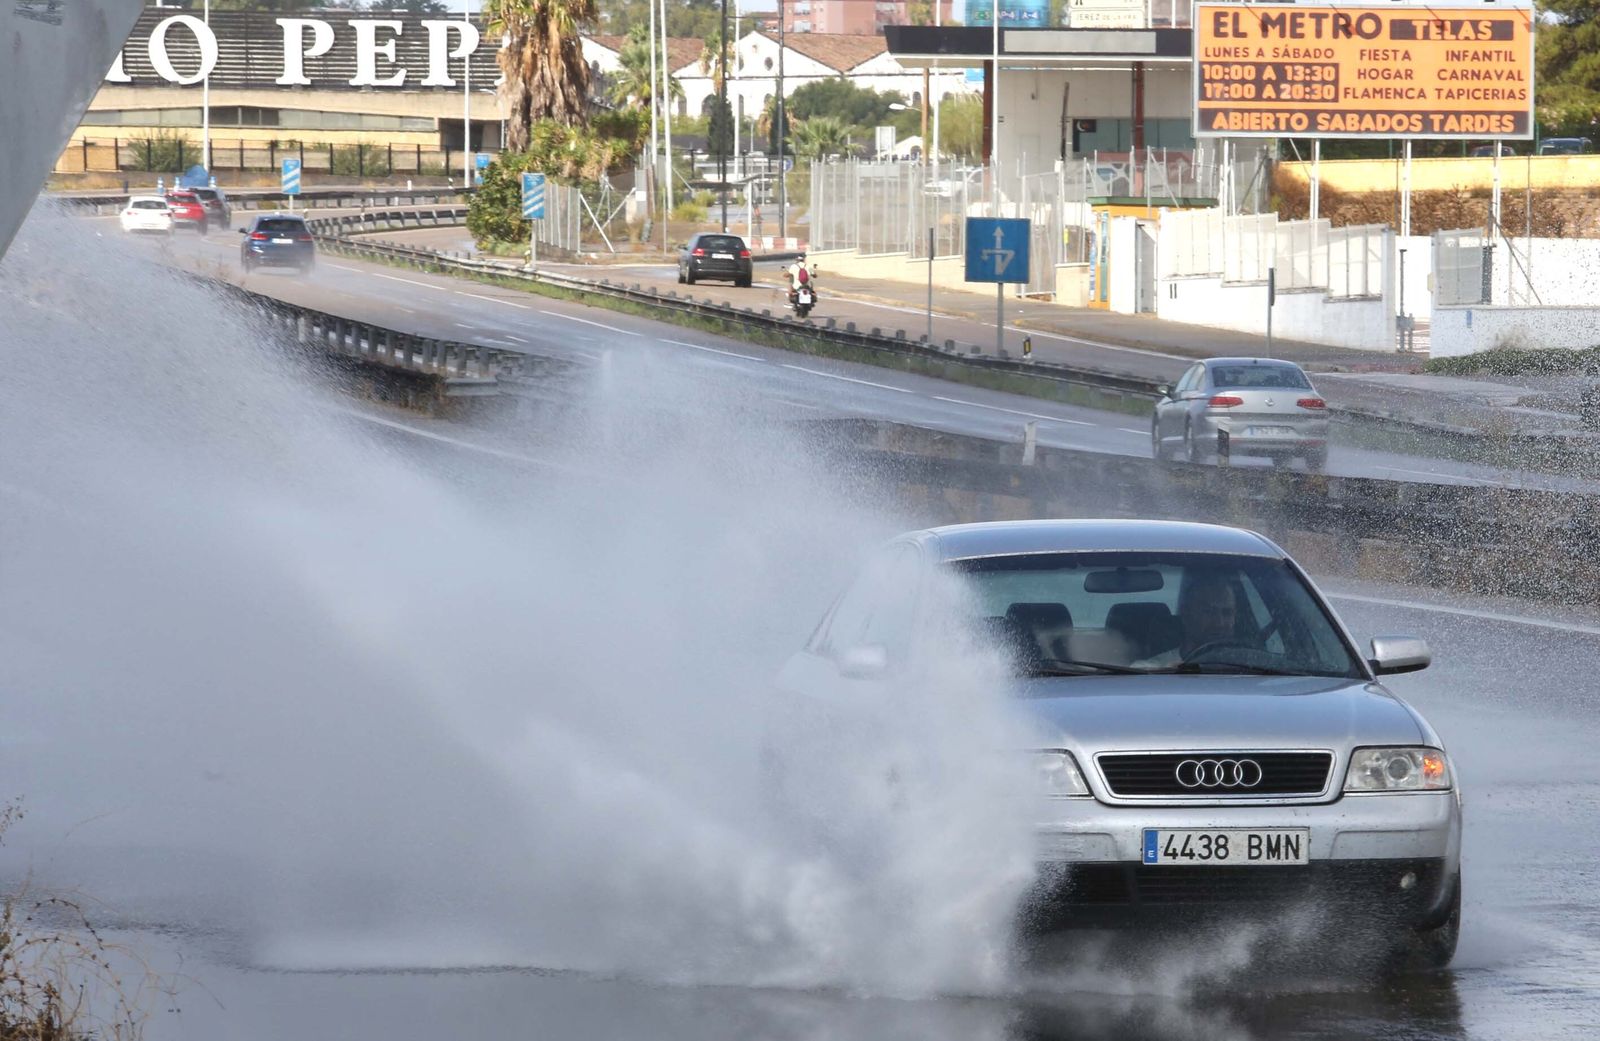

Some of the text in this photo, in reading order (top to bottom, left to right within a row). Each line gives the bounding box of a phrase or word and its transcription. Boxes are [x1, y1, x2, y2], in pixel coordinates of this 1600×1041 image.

[1213, 11, 1383, 40] EL METRO
[1412, 20, 1492, 40] TELAS
[276, 18, 511, 87] PEP
[1204, 44, 1335, 59] LUNES A SÁBADO
[1359, 49, 1412, 61] FIESTA
[1446, 50, 1516, 62] INFANTIL
[1202, 64, 1336, 81] 10:00 A 13:30
[1358, 68, 1414, 80] HOGAR
[1437, 69, 1525, 81] CARNAVAL
[1203, 83, 1336, 100] 17:00 A 20:30
[1343, 87, 1427, 99] FLAMENCA
[1435, 88, 1527, 100] TAPICERIAS
[1212, 111, 1515, 132] ABIERTO SABADOS TARDES
[1147, 850, 1155, 858] E
[1163, 834, 1300, 860] 4438 BMN
